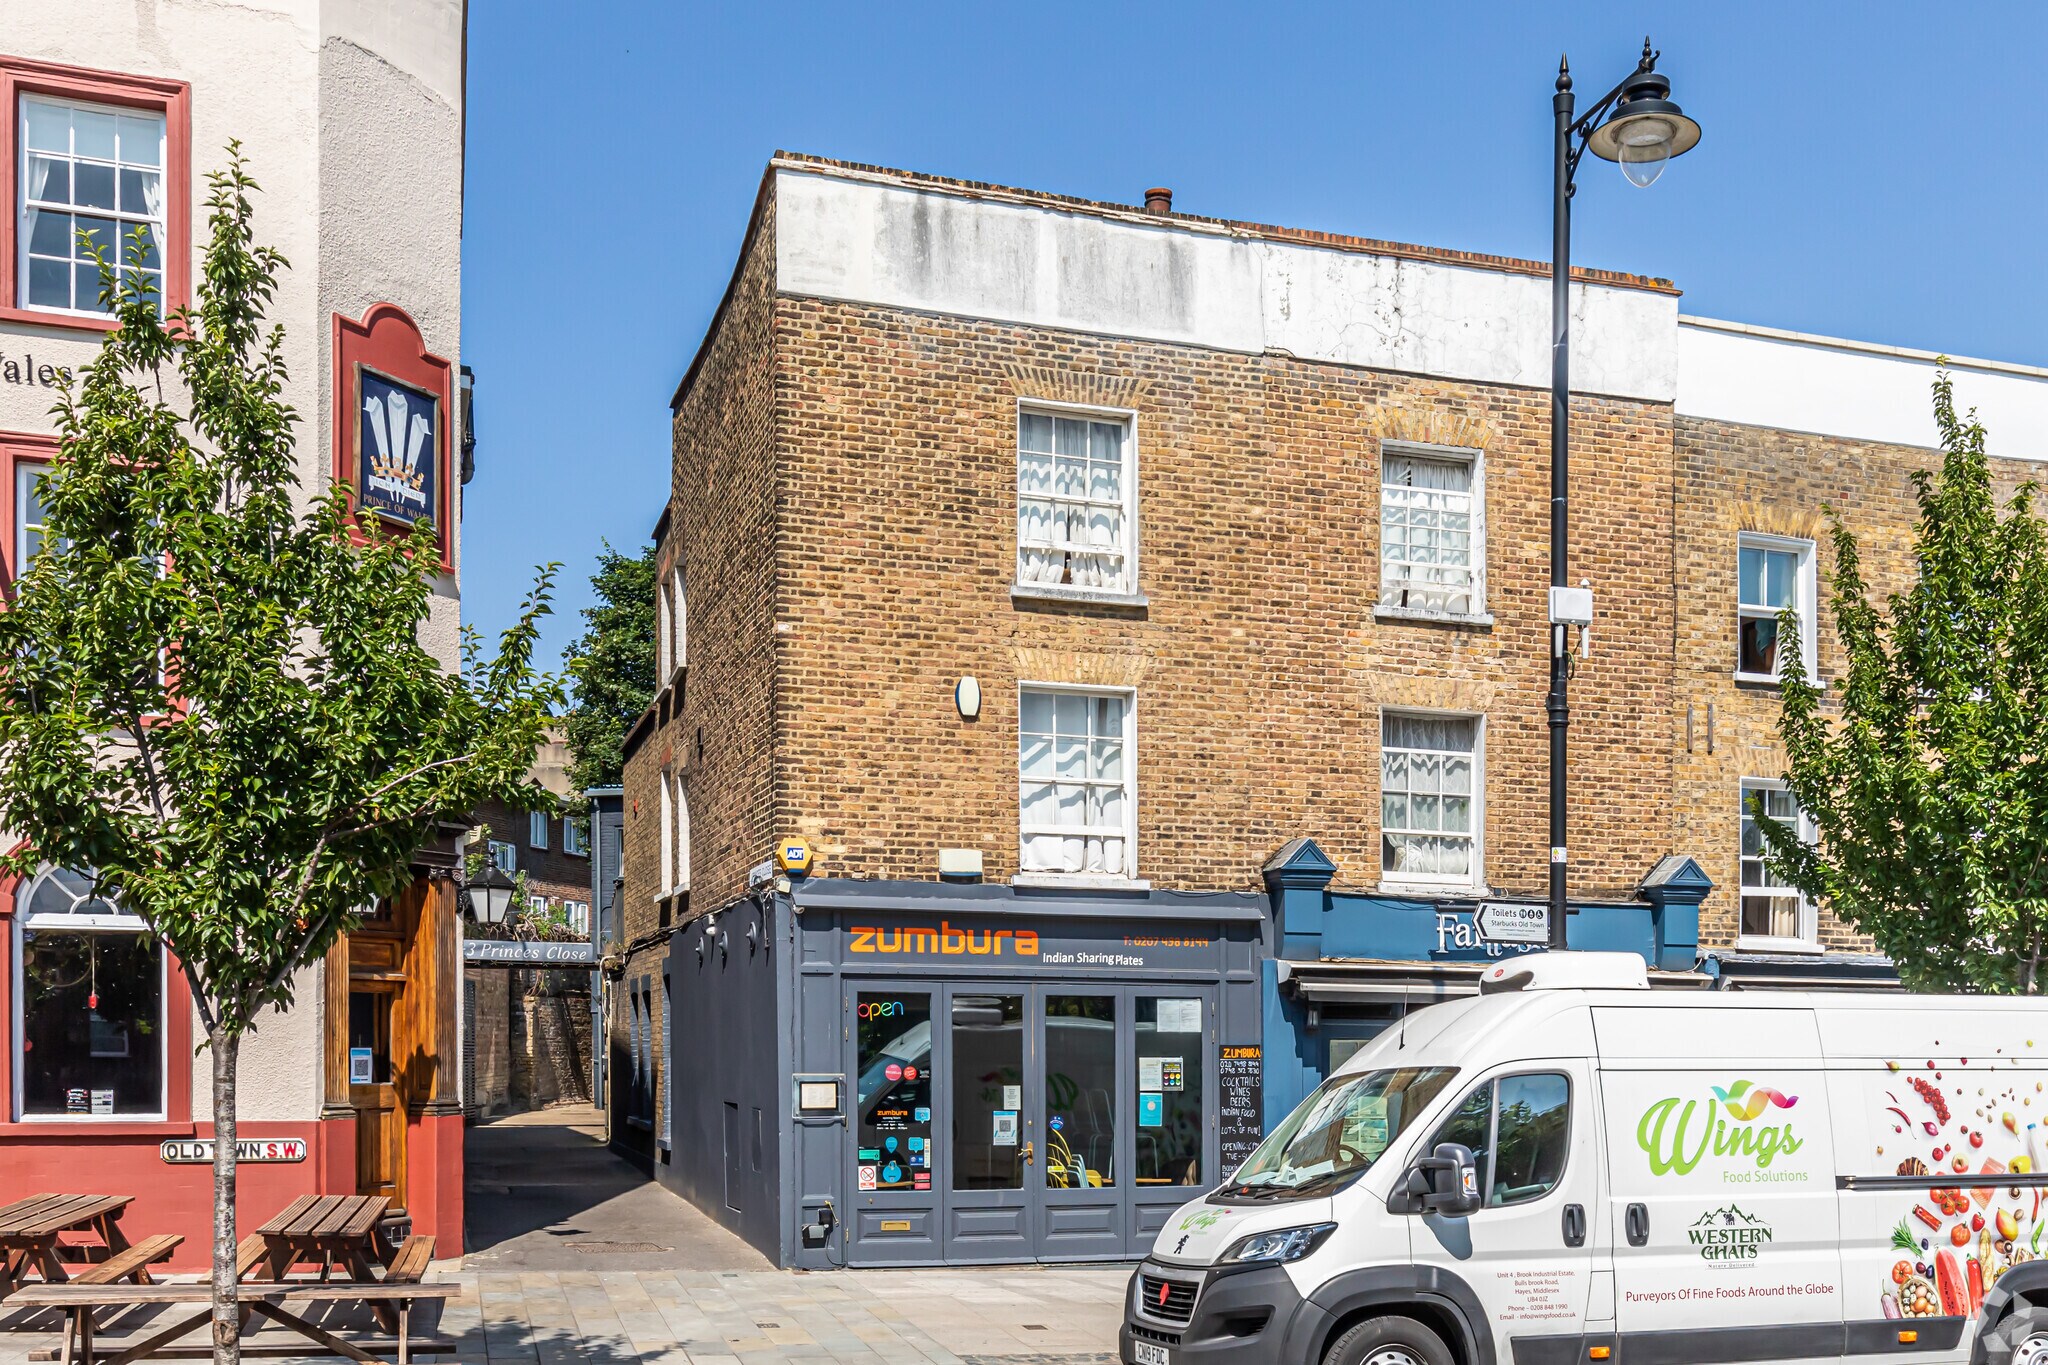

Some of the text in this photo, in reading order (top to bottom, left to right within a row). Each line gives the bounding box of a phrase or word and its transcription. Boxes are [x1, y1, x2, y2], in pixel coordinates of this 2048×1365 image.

[0, 352, 74, 389] ales
[363, 493, 392, 511] PRINCE
[394, 504, 405, 514] OF
[787, 848, 804, 859] ADT
[1491, 908, 1517, 918] Toilets
[1491, 919, 1518, 928] Starbucks
[850, 921, 1039, 955] zumbura
[1123, 936, 1209, 948] T: 0207 498 8144
[480, 943, 540, 960] Princes
[546, 946, 587, 960] Close
[1043, 952, 1144, 966] Indian Sharing Plates
[858, 1002, 904, 1021] open
[1223, 1047, 1261, 1059] ZUMBURA
[1221, 1076, 1260, 1088] COCKTAILS
[1230, 1087, 1251, 1097] WINES
[1230, 1096, 1251, 1107] BEERS
[1240, 1108, 1256, 1118] FOOD
[1221, 1126, 1237, 1135] LOTS
[1637, 1097, 1804, 1177] Wings
[166, 1143, 205, 1159] OLD
[1723, 1169, 1809, 1183] Food Solutions
[1687, 1227, 1773, 1245] WESTERN
[1701, 1244, 1758, 1260] GHATS
[1626, 1283, 1834, 1303] Purveyors Of Fine Foods Around the Globe
[1519, 1312, 1576, 1321] info@wingsfood.co.uk
